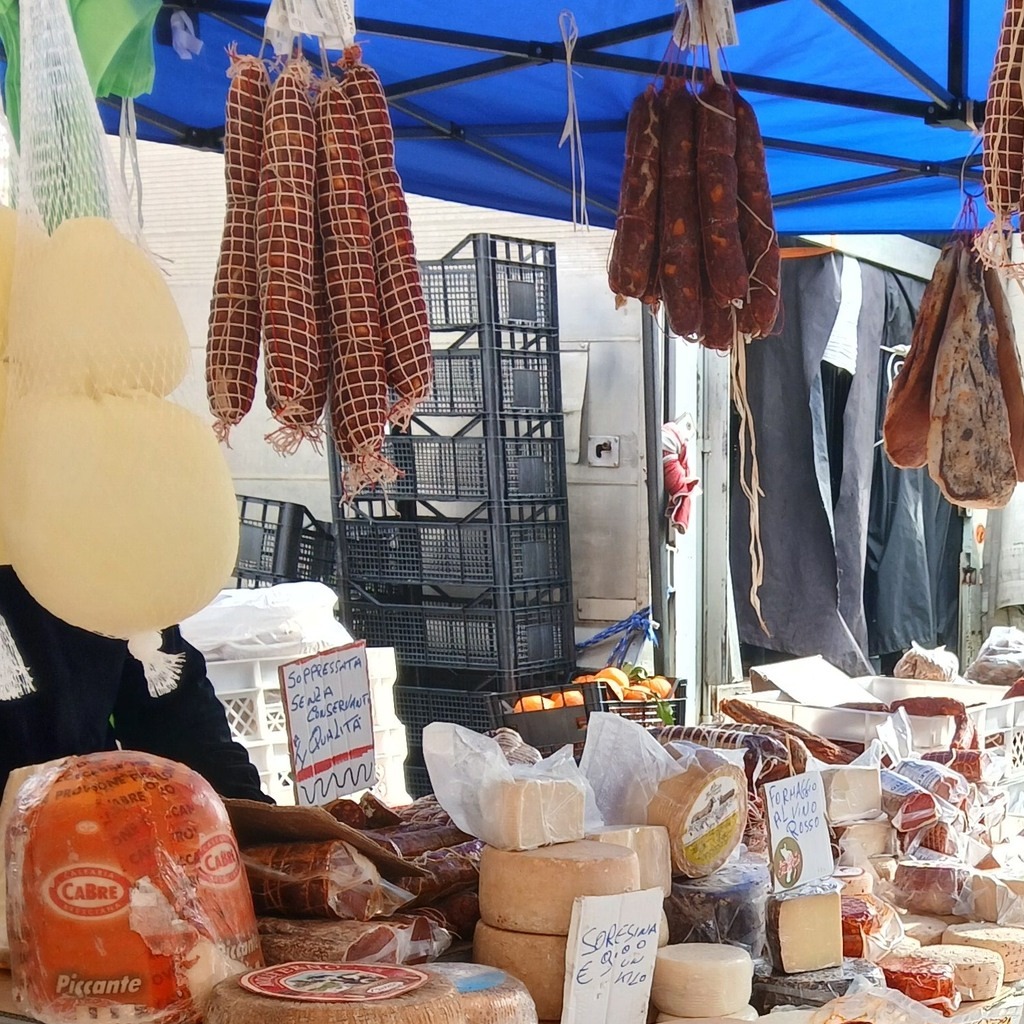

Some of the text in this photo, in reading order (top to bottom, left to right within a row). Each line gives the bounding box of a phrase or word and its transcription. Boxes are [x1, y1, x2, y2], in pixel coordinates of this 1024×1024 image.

[291, 686, 333, 712] SENZA
[769, 779, 817, 807] FORMAGGIO
[774, 801, 817, 829] AL VINO
[786, 816, 819, 840] ROSSO
[581, 923, 657, 956] SORESINA
[56, 973, 142, 998] Piccante
